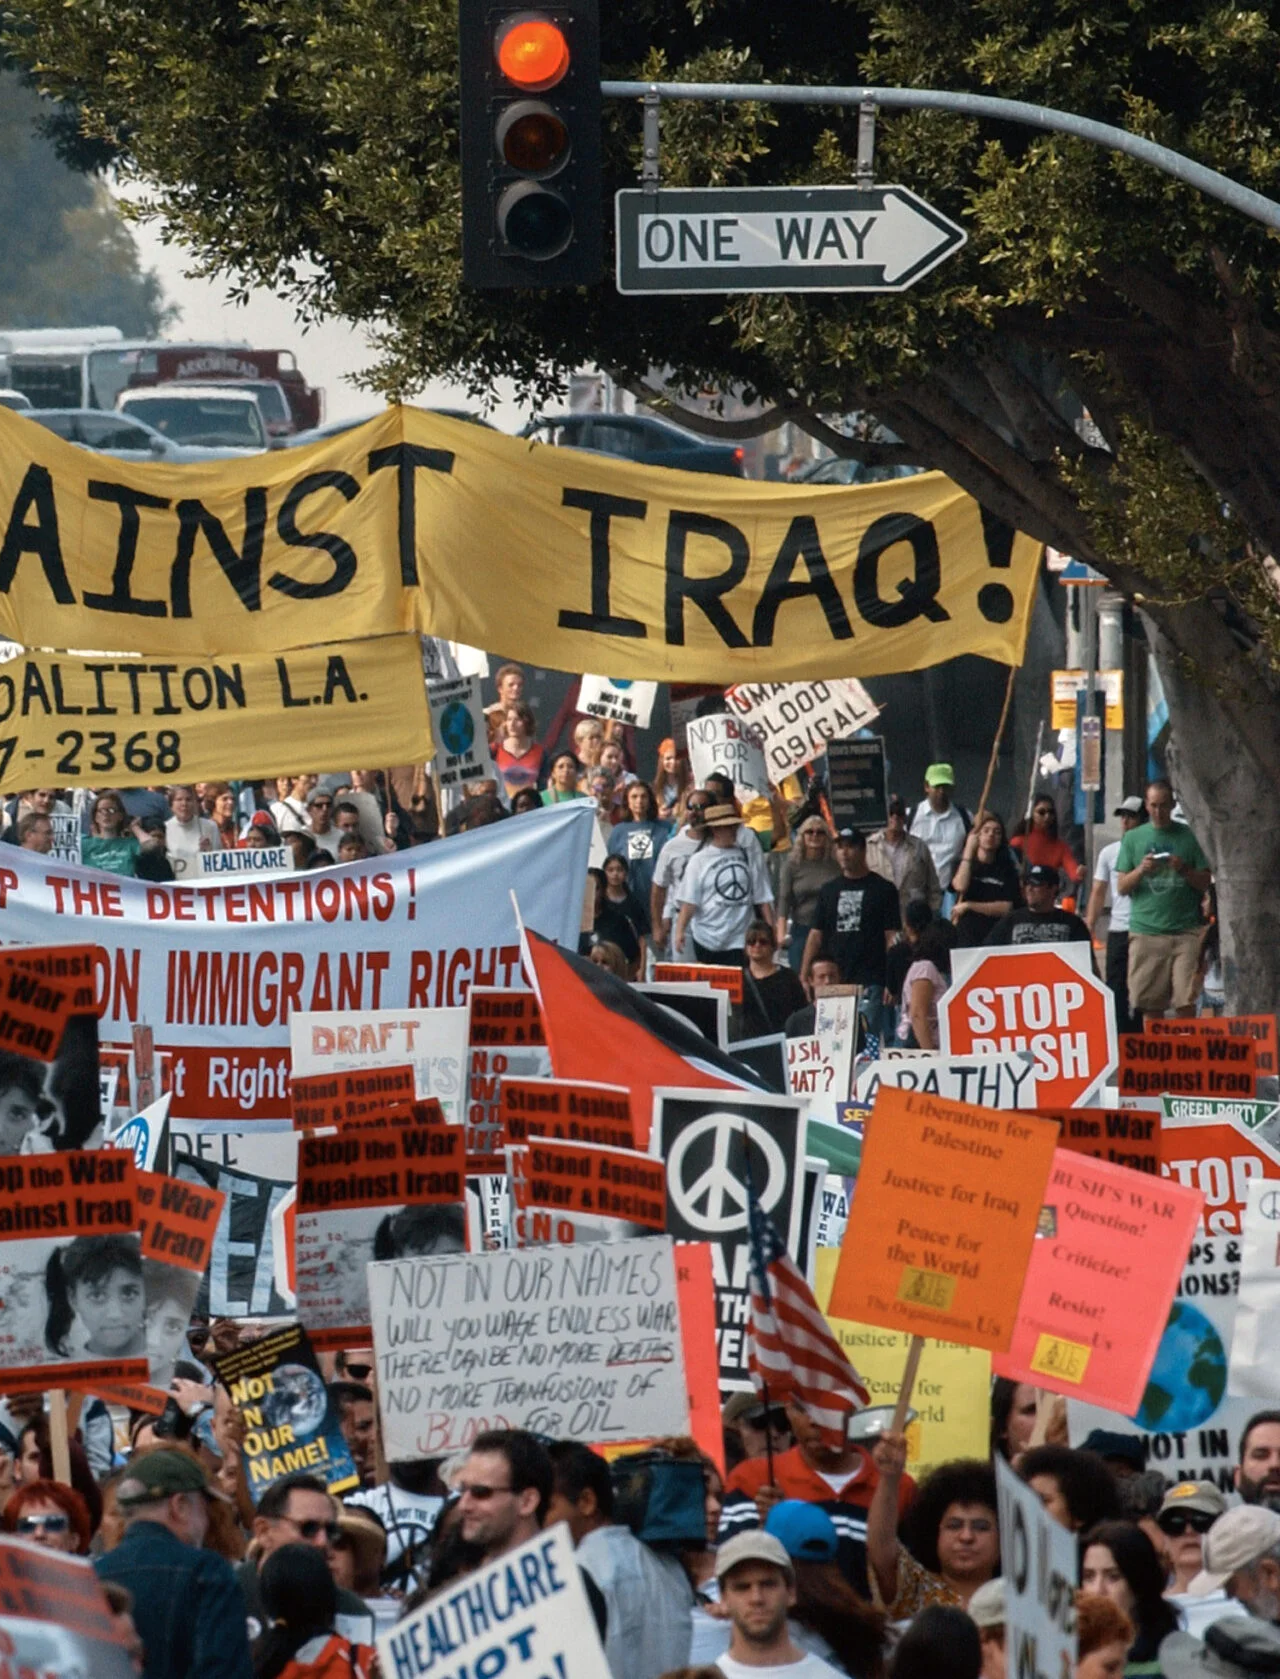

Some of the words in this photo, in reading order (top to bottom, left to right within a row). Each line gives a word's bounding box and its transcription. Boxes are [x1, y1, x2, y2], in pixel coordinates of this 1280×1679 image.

[644, 218, 740, 262] ONE
[775, 216, 877, 260] WAY
[558, 487, 1016, 648] IRAQ!
[282, 654, 369, 706] L.A.
[751, 681, 831, 742] BLOOD
[690, 719, 717, 750] NO
[712, 743, 749, 762] FOR
[203, 849, 287, 872] HEALTHCARE
[46, 875, 124, 917] THE
[6, 971, 66, 1014] War
[166, 950, 389, 1027] IMMIGRANT
[473, 999, 524, 1018] Stand
[966, 981, 1085, 1034] STOP
[311, 1020, 420, 1056] DRAFT
[472, 1024, 506, 1042] War
[1228, 1020, 1270, 1040] War
[472, 1050, 508, 1074] No
[1124, 1037, 1172, 1062] Stop
[1176, 1040, 1202, 1060] the
[1206, 1039, 1250, 1061] War
[294, 1081, 338, 1102] Stand
[344, 1071, 411, 1096] Against
[1123, 1068, 1203, 1092] Against
[1208, 1070, 1251, 1093] Iraq
[295, 1106, 325, 1126] War
[506, 1087, 560, 1114] Stand
[567, 1092, 629, 1121] Against
[905, 1097, 1000, 1133] Liberation
[1006, 1119, 1033, 1141] for
[1171, 1100, 1212, 1118] GREEN
[920, 1126, 1004, 1160] Palestine
[1070, 1115, 1101, 1137] the
[1104, 1115, 1155, 1139] War
[303, 1137, 360, 1168] Stop
[365, 1139, 396, 1160] the
[401, 1130, 459, 1158] War
[29, 1166, 63, 1187] the
[68, 1155, 127, 1185] War
[299, 1172, 399, 1206] Against
[405, 1169, 460, 1197] Iraq
[532, 1148, 591, 1180] Stand
[599, 1155, 664, 1201] Against
[75, 1196, 133, 1227] Iraq
[160, 1182, 217, 1222] War
[531, 1178, 574, 1208] War
[597, 1191, 664, 1228] Racism
[882, 1169, 945, 1199] Justice
[950, 1184, 978, 1204] for
[983, 1191, 1019, 1218] Iraq
[1052, 1169, 1122, 1200] BUSH'S
[1129, 1192, 1177, 1220] WAR
[897, 1218, 949, 1246] Peace
[956, 1234, 982, 1254] for
[1064, 1201, 1147, 1238] Question!
[150, 1221, 208, 1266] Iraq
[390, 1261, 462, 1309] NOT
[504, 1257, 554, 1302] OUR
[560, 1248, 662, 1300] NAMES
[887, 1244, 916, 1265] the
[923, 1251, 980, 1280] World
[1052, 1243, 1132, 1281] Criticize!
[1048, 1291, 1106, 1319] Resist!
[386, 1315, 432, 1347] WILL
[485, 1309, 540, 1342] WAGE
[547, 1304, 631, 1334] ENDLESS
[636, 1300, 677, 1332] WAR
[838, 1328, 897, 1348] Justice
[976, 1315, 1001, 1337] Us
[380, 1350, 448, 1381] THERE
[450, 1348, 486, 1377] CAN
[488, 1344, 518, 1367] BE
[520, 1344, 548, 1368] NO
[549, 1341, 602, 1367] MORE
[607, 1337, 675, 1366] DEATHS
[229, 1373, 276, 1406] NOT
[386, 1388, 420, 1414] NO
[429, 1381, 486, 1410] MORE
[626, 1369, 663, 1397] OF
[918, 1379, 944, 1396] for
[524, 1406, 562, 1435] FOR
[243, 1424, 296, 1457] OUR
[1200, 1427, 1229, 1458] IN
[249, 1436, 331, 1484] NAME!
[389, 1539, 566, 1679] HEALTHCARE
